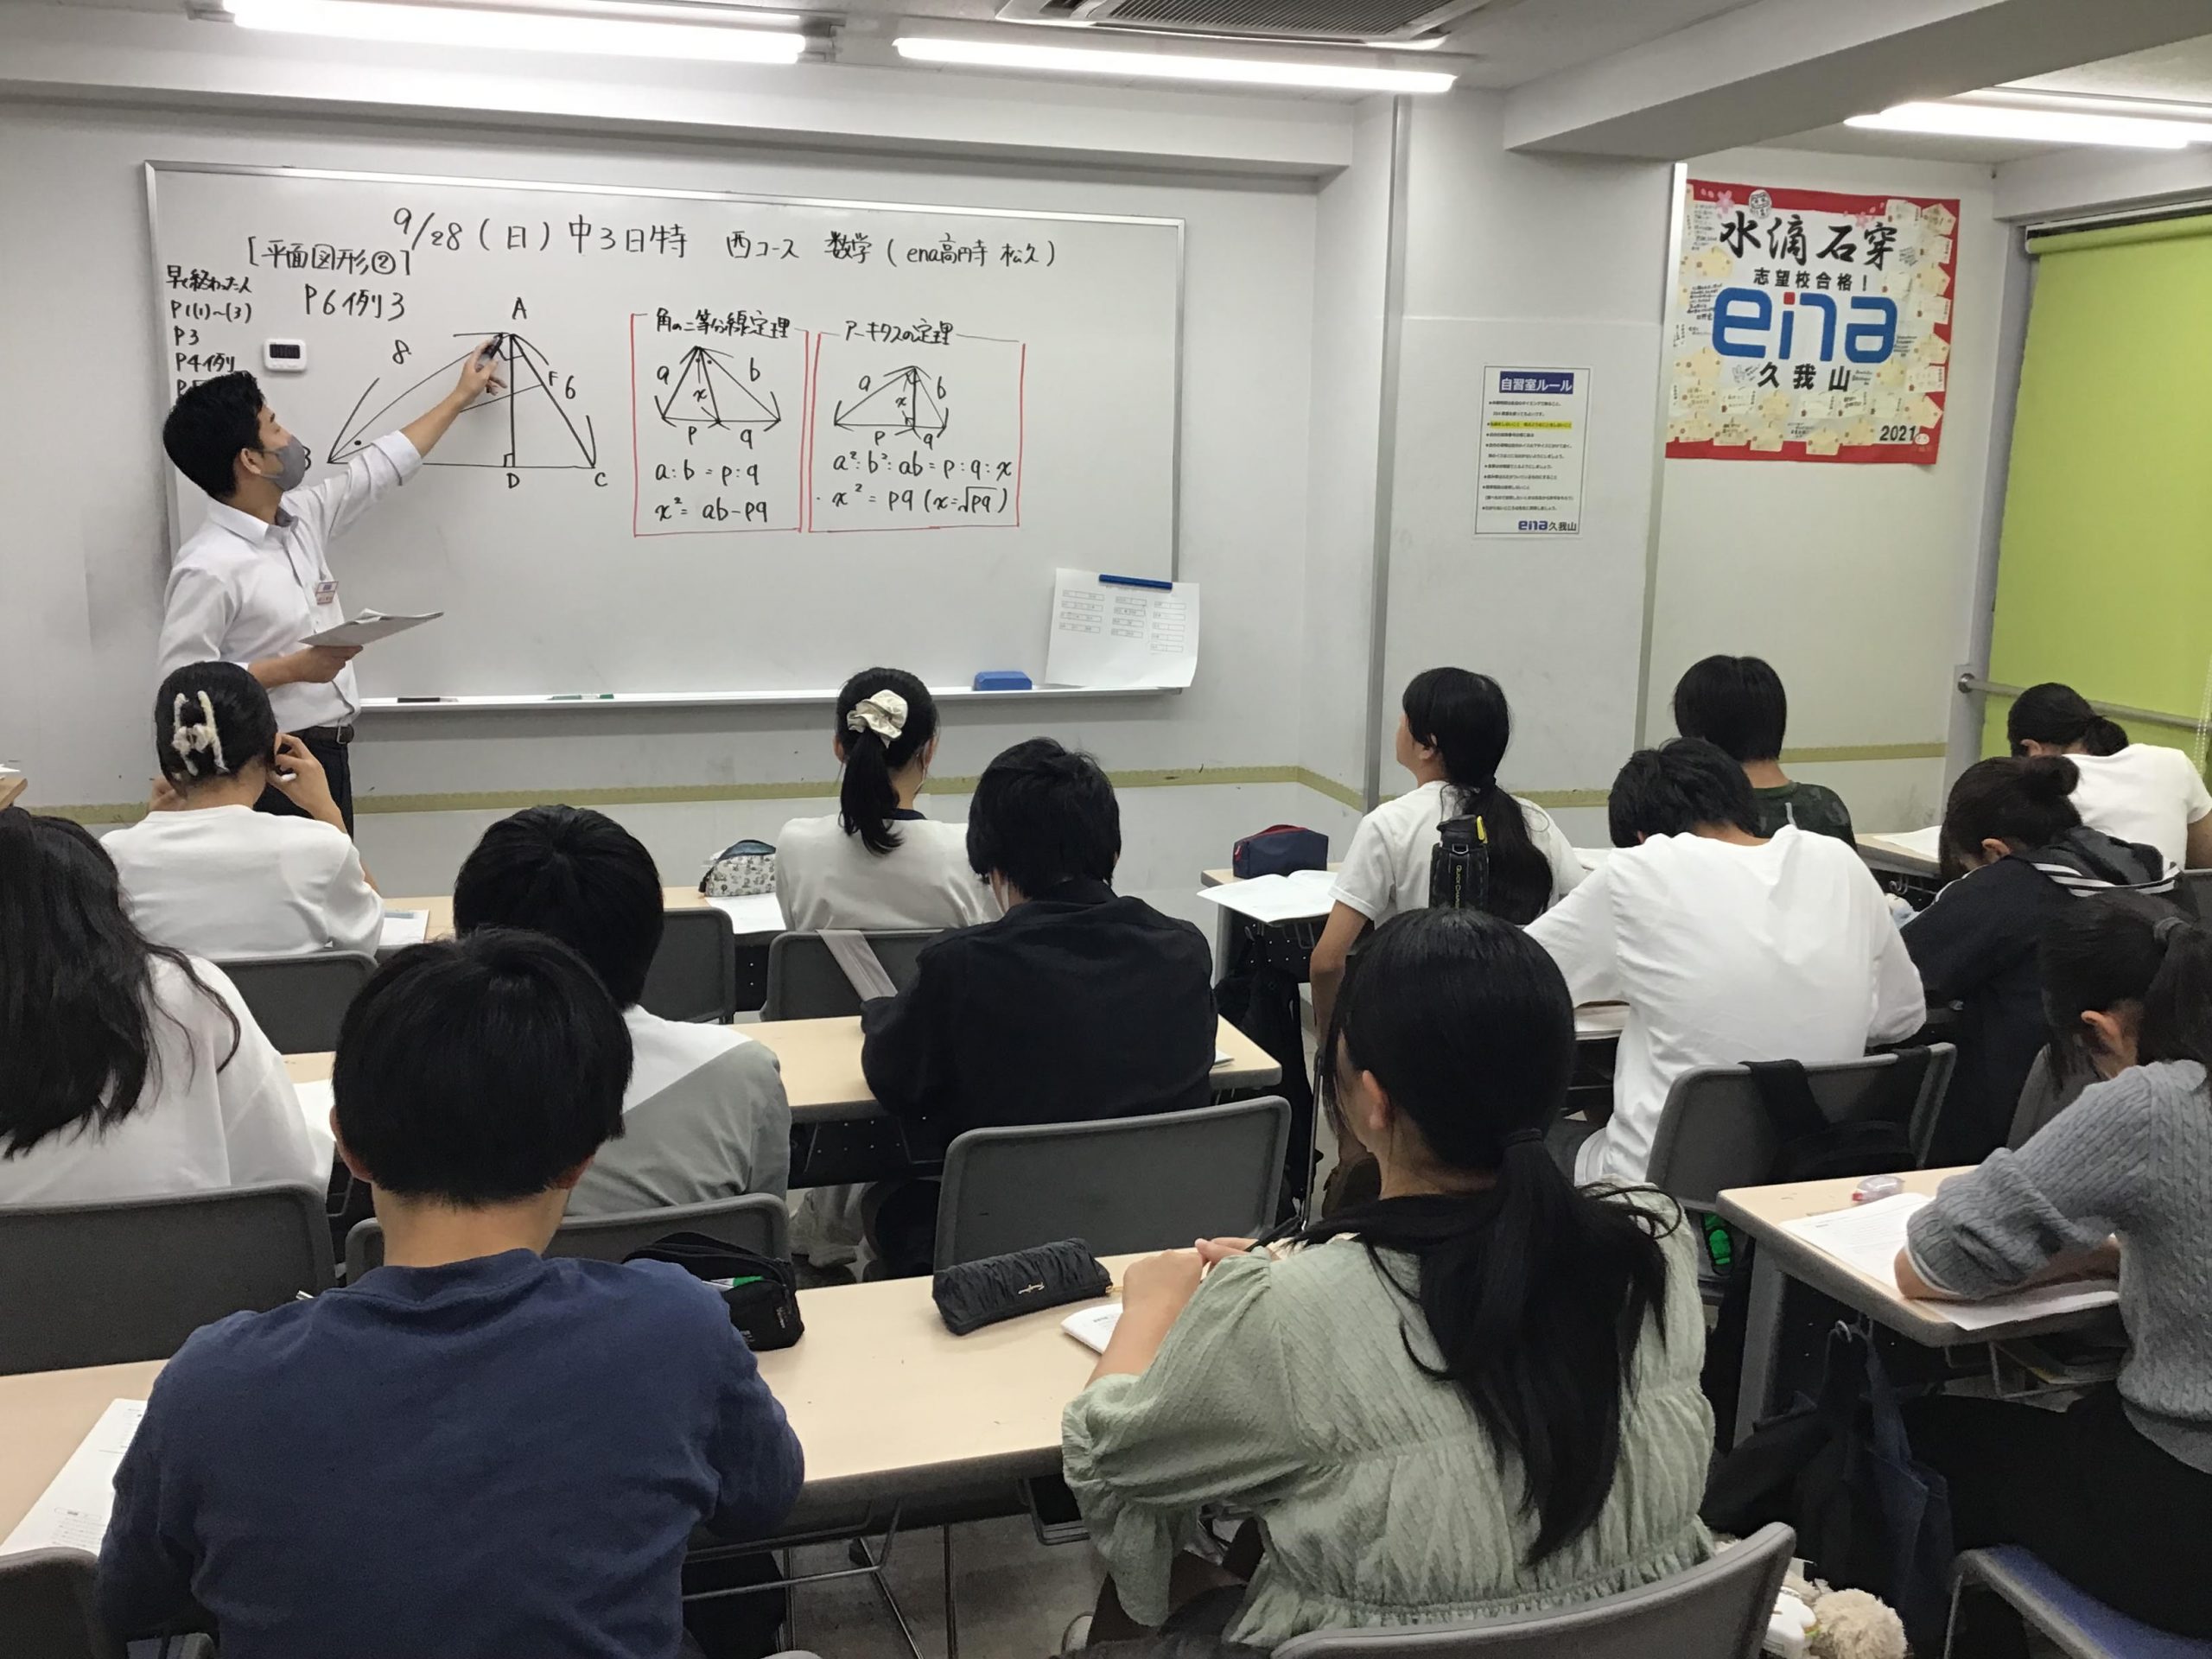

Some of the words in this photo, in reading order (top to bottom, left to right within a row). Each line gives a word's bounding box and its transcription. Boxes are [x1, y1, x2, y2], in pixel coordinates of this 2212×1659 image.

[1719, 210, 1898, 271] 水滴石穿
[512, 296, 528, 321] A
[1712, 286, 1898, 365] ena
[750, 356, 761, 383] b
[1757, 361, 1852, 392] 久我山
[564, 375, 577, 401] 6
[937, 375, 947, 400] b
[1500, 377, 1573, 393] 自習室ルール
[1878, 424, 1917, 442] 2021
